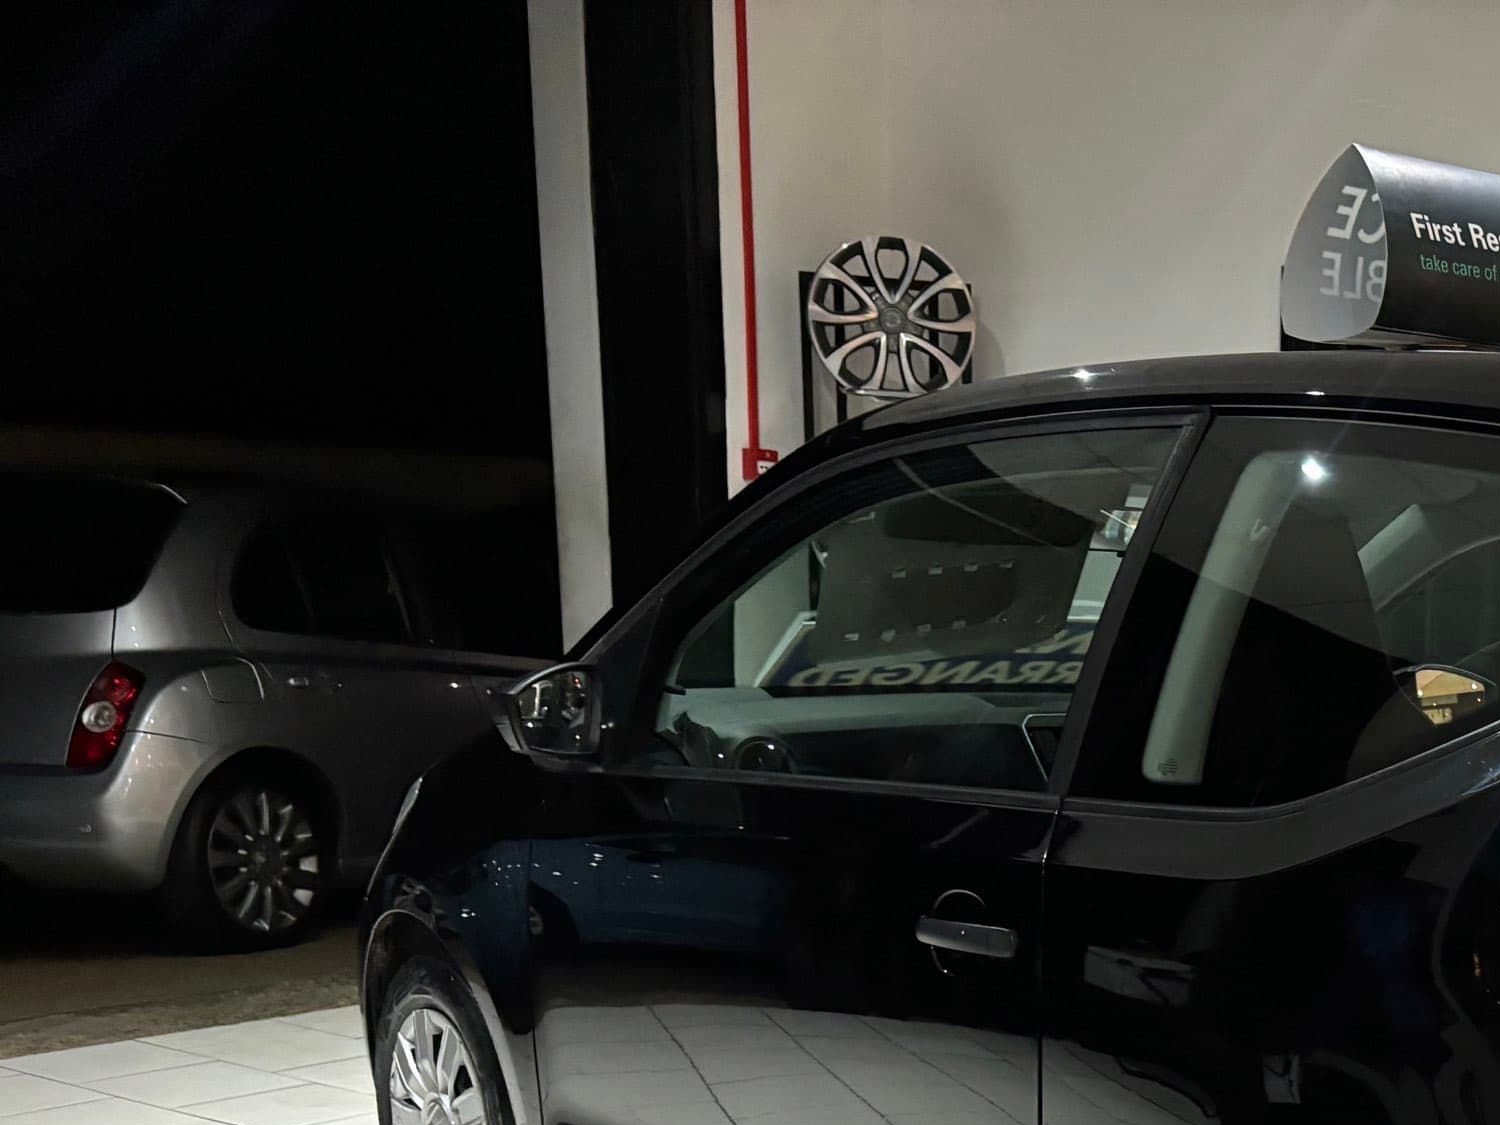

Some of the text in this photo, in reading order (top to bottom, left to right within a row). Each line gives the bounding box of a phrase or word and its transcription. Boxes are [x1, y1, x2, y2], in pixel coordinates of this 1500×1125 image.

[1409, 212, 1466, 247] First
[1420, 254, 1449, 274] take
[1452, 261, 1481, 279] care
[1484, 265, 1498, 281] of
